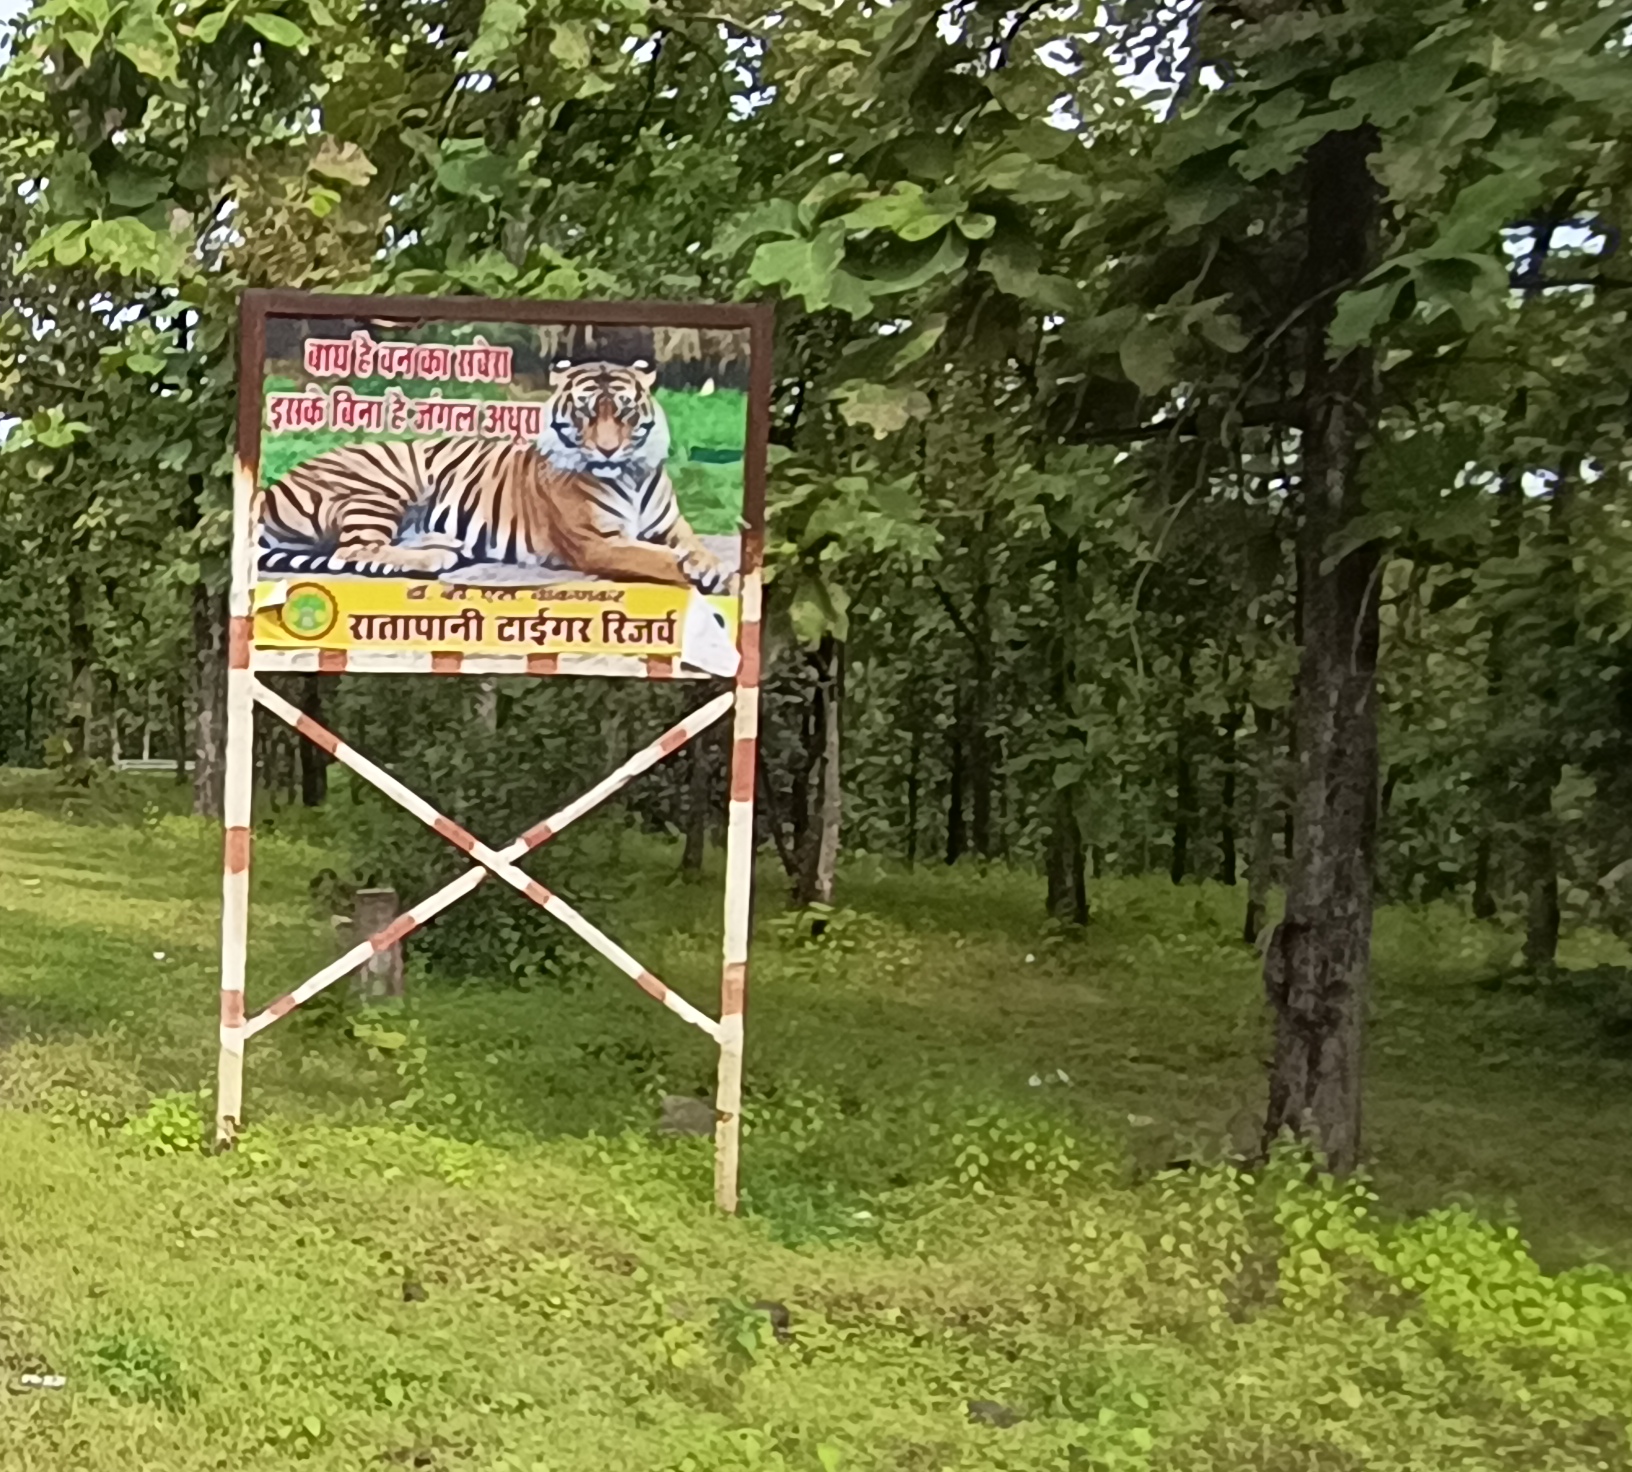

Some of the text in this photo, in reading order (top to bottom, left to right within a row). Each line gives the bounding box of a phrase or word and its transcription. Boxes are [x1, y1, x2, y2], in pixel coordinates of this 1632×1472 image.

[379, 345, 415, 377] वन
[418, 347, 450, 376] का
[271, 387, 325, 430] इसके
[331, 390, 384, 429] बिना
[413, 392, 478, 432] जंगल
[483, 404, 542, 444] अधूरा
[347, 607, 678, 645] रातापानी टाईगर रिजर्व
